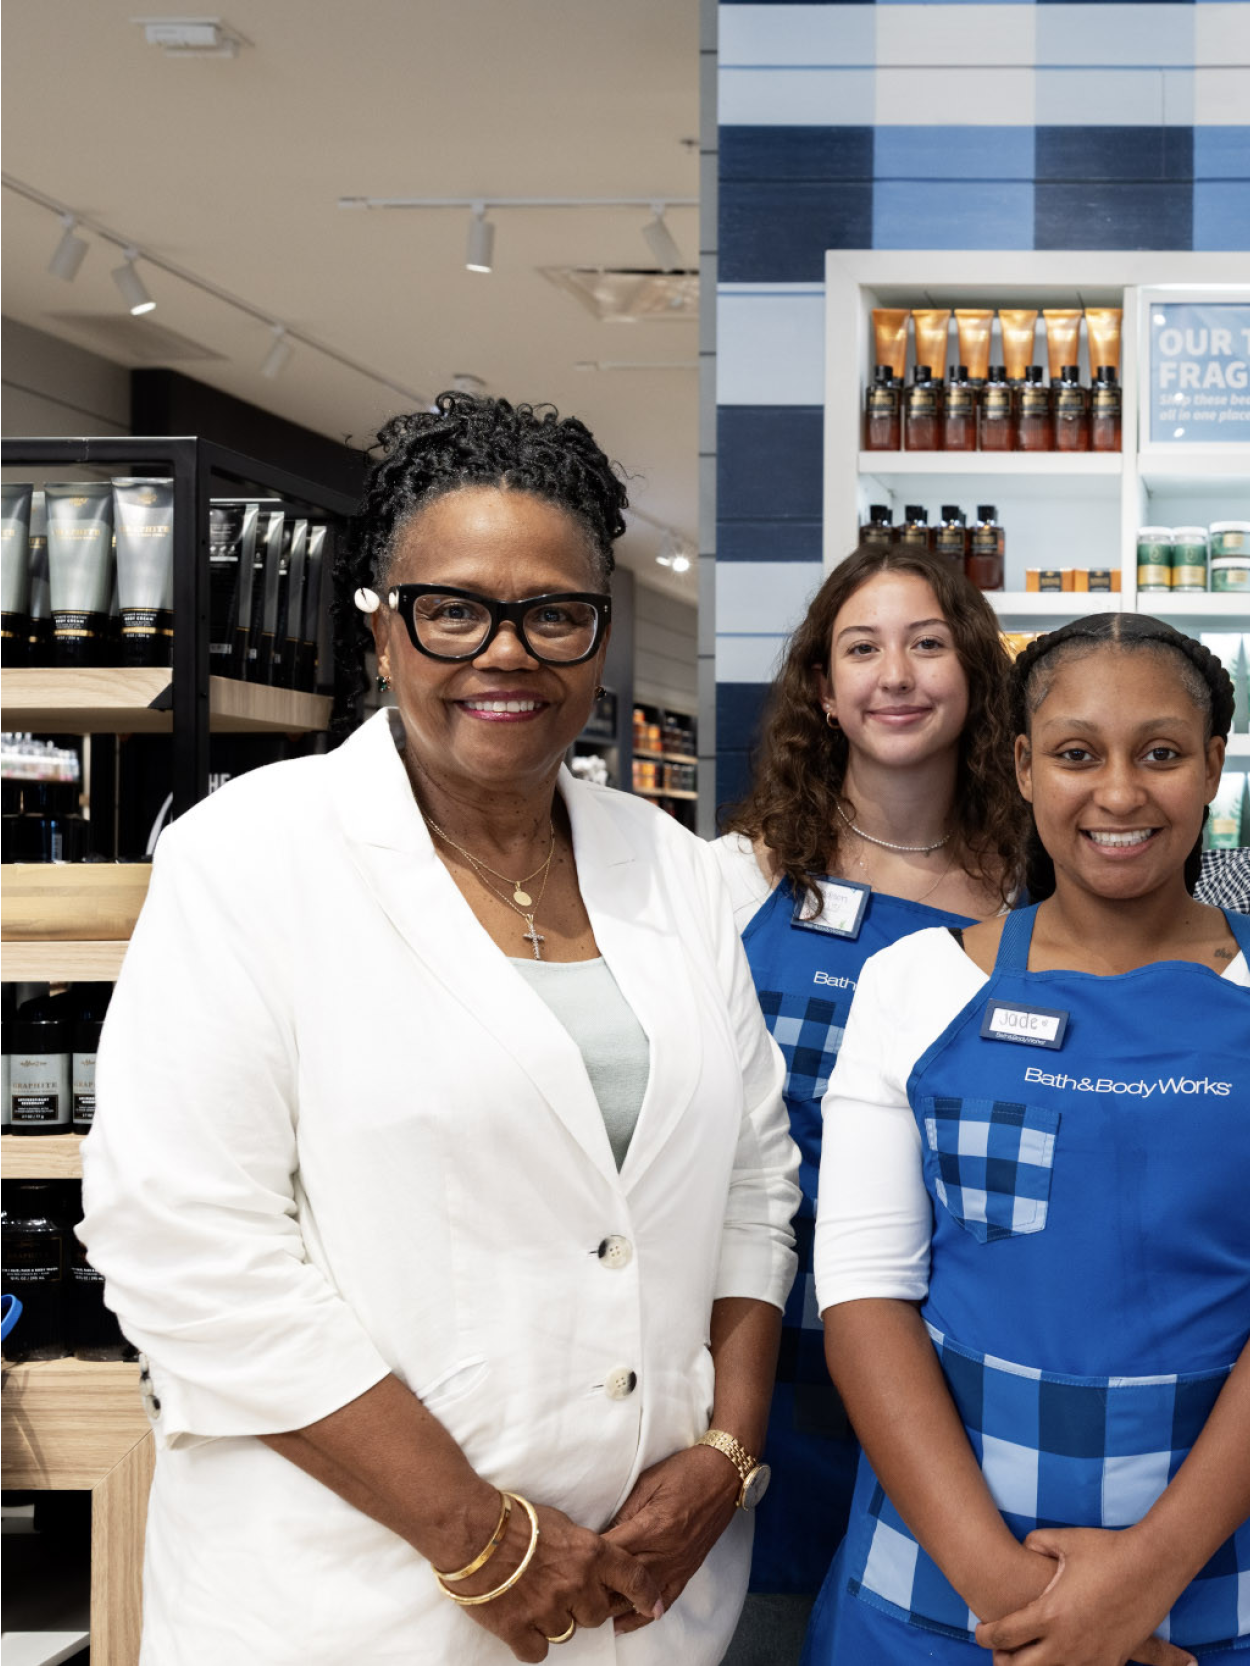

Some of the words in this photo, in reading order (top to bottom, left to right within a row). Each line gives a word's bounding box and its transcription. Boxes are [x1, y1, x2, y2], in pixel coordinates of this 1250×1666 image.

[1159, 328, 1232, 356] OUR
[1159, 409, 1176, 421] all
[1178, 409, 1191, 421] in
[1193, 411, 1217, 421] one
[999, 1012, 1037, 1030] Jade
[1024, 1067, 1156, 1099] Bath&Body
